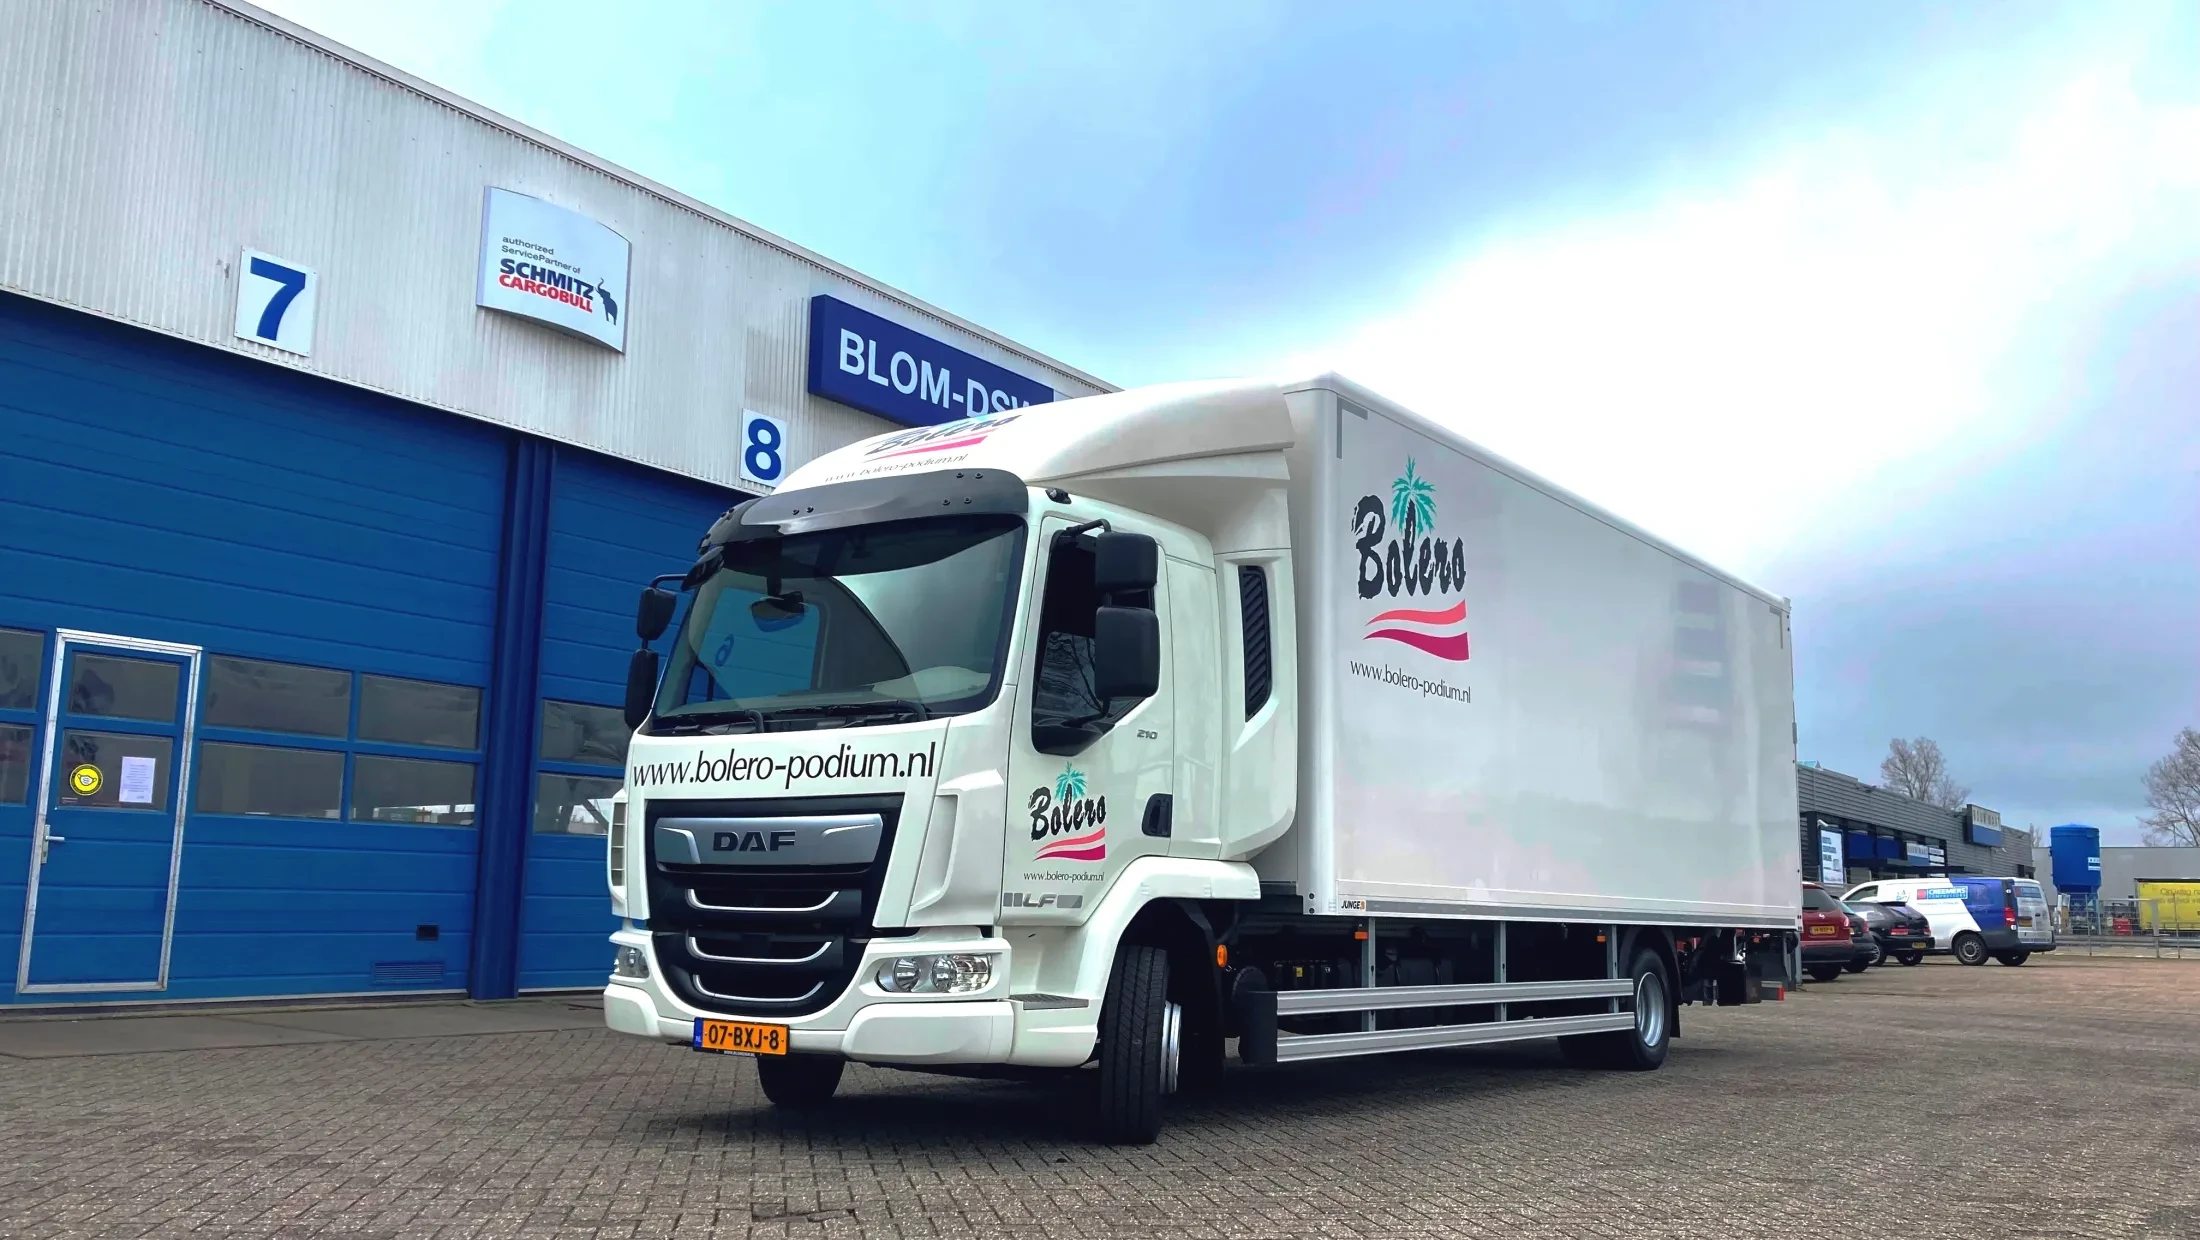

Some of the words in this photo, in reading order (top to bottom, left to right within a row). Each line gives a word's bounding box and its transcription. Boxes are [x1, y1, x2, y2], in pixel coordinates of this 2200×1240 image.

[502, 236, 555, 256] authorized
[500, 258, 594, 301] SCHMITZ
[572, 266, 581, 275] of
[250, 256, 306, 341] 7
[499, 274, 593, 313] CARGOBULL
[745, 418, 782, 481] 8
[1351, 495, 1466, 600] Bolero
[1350, 660, 1471, 703] www.bolero-podium.nl
[1136, 729, 1158, 741] 210
[633, 741, 936, 789] www.bolero-podium.nl
[1028, 783, 1106, 841] Bolero
[712, 831, 796, 852] DAF
[1024, 871, 1105, 884] www.bolero-podium.nl
[1022, 894, 1057, 908] LF
[1341, 900, 1361, 910] JUNGE
[708, 1024, 779, 1050] 07-BXJ-8
